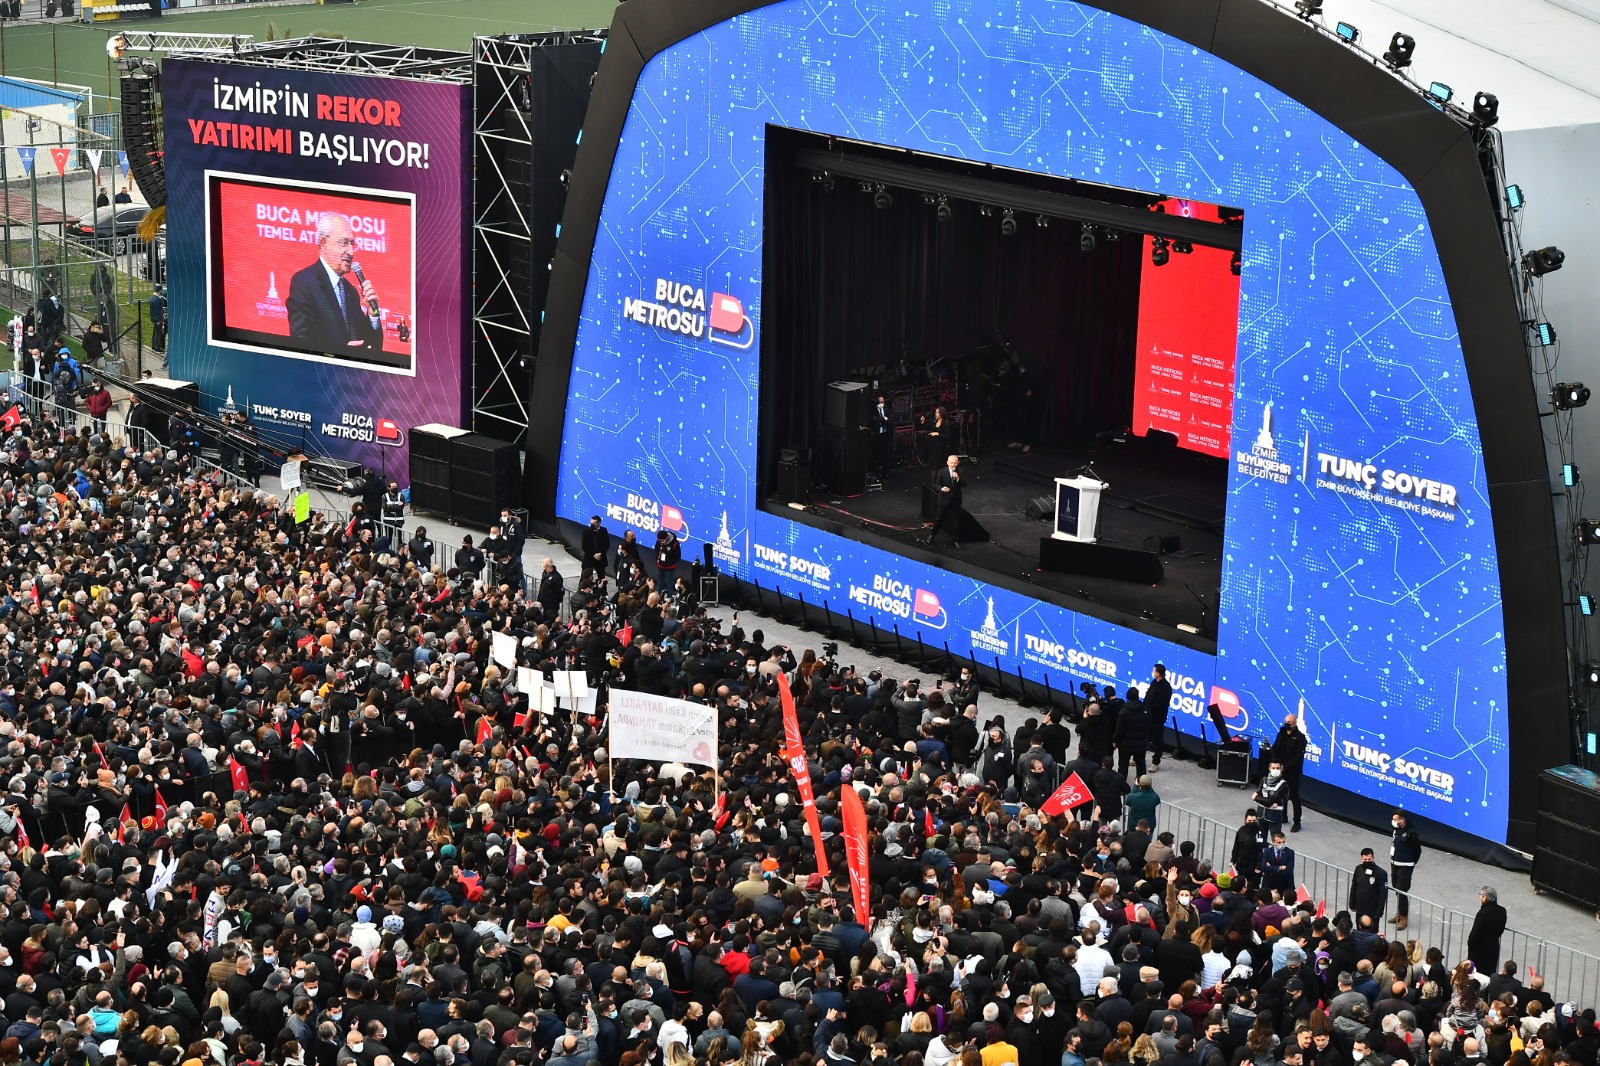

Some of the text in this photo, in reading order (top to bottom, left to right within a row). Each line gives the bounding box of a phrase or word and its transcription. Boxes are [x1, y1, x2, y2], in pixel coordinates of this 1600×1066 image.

[317, 94, 401, 128] REKOR
[187, 118, 429, 170] YATIRIMI BAŞLIYOR!
[256, 203, 302, 225] BUCA
[256, 224, 296, 242] TEMEL
[655, 278, 705, 311] BUCA
[623, 296, 704, 337] METROSU
[253, 404, 279, 419] TUNÇ
[280, 408, 312, 423] SOYER
[342, 412, 373, 429] BUCA
[321, 423, 373, 442] METROSU
[1237, 451, 1291, 475] BÜYÜKŞEHİR
[1238, 464, 1288, 484] BELEDİYESİ
[1317, 452, 1457, 506] TUNÇ SOYER
[627, 493, 659, 517] BUCA
[1317, 477, 1454, 521] İZMİR BÜYÜKŞEHİR BELEDİYE BAŞKANI
[607, 502, 658, 533] METROSU
[754, 544, 830, 581] TUNÇ SOYER
[849, 584, 910, 618] METROSU
[873, 574, 911, 602] BUCA
[1025, 634, 1117, 677] TUNÇ SOYER
[1341, 760, 1453, 803] İZMİR BÜYÜKŞEHİR BELEDİYE BAŞKANI
[1342, 740, 1454, 791] TUNÇ SOYER
